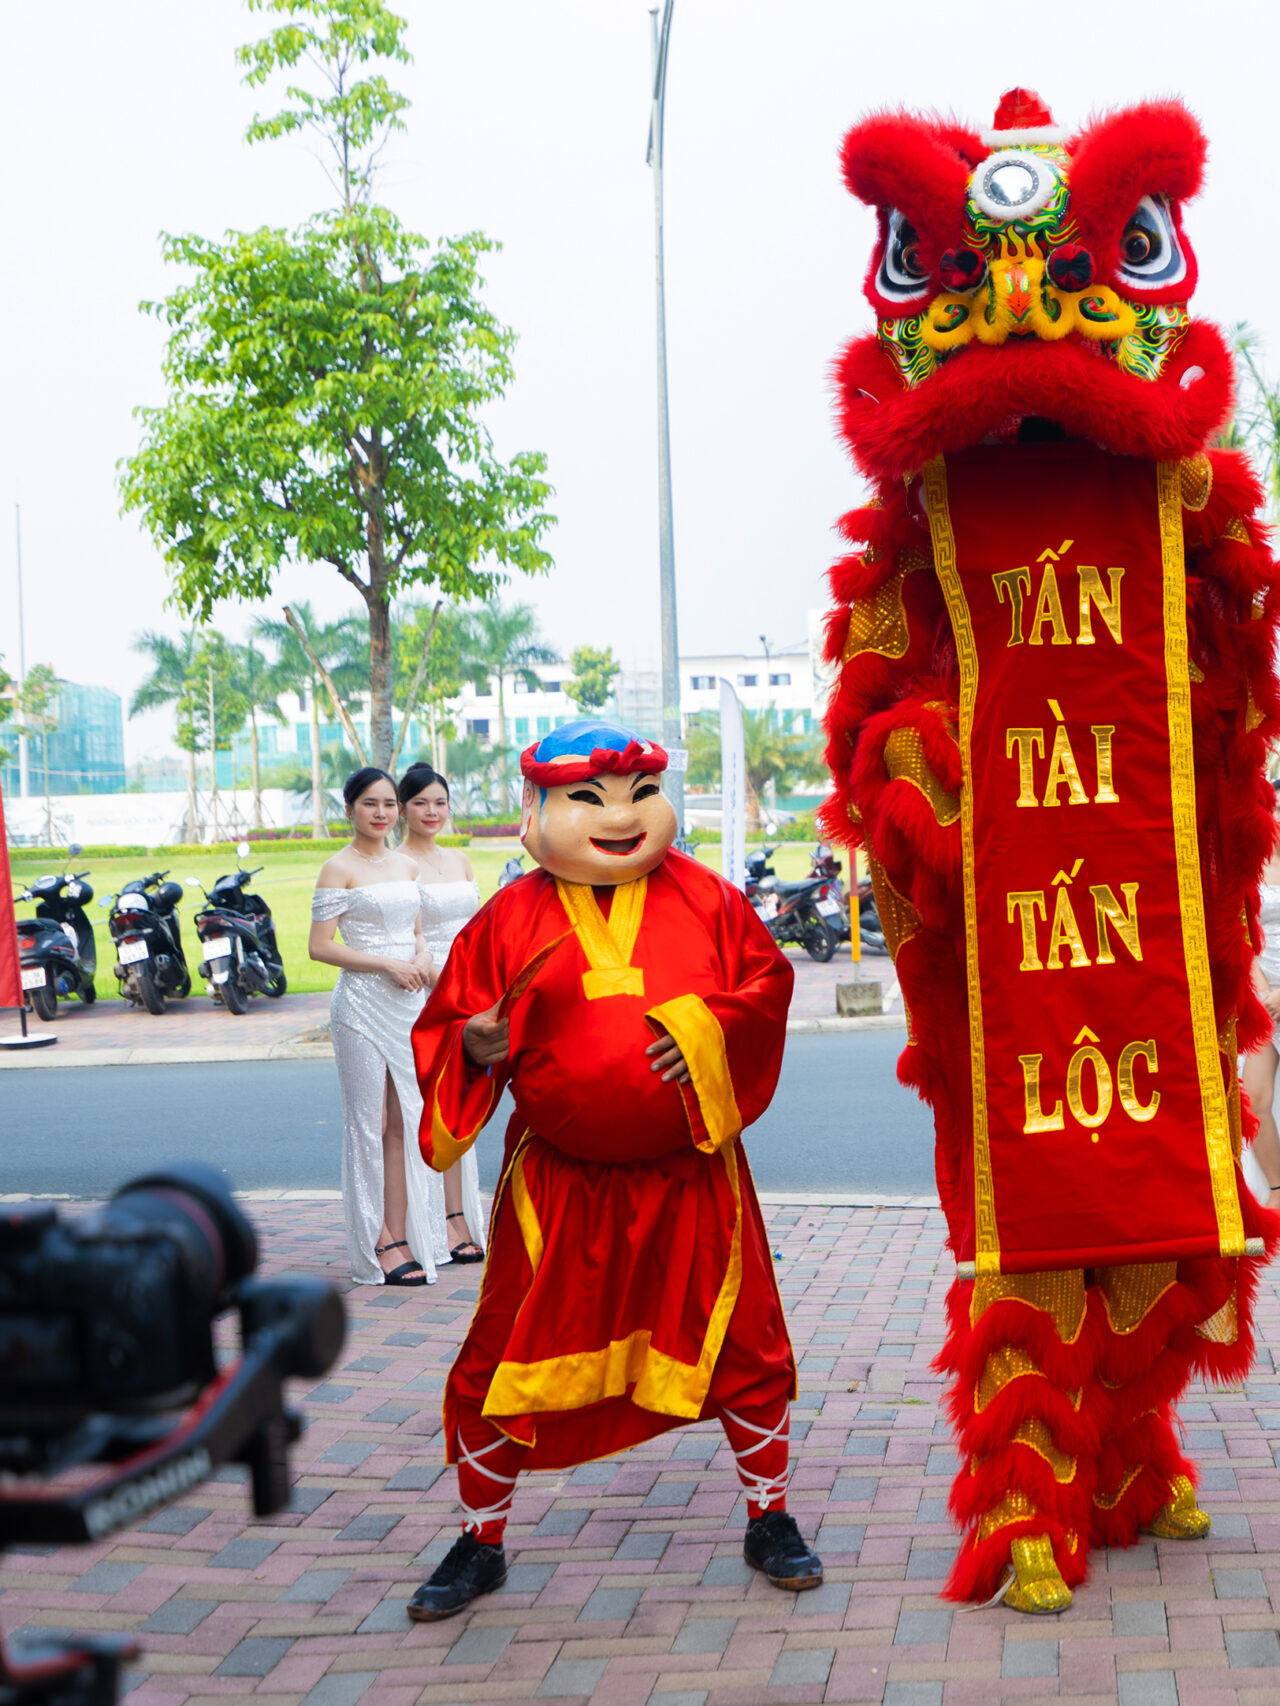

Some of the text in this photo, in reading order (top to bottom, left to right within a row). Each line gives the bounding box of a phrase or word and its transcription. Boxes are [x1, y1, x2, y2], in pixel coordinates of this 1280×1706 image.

[992, 540, 1125, 647] TẤN
[1006, 699, 1120, 807] TÀI
[1007, 859, 1144, 971] TẤN
[1018, 1025, 1161, 1143] LỘC
